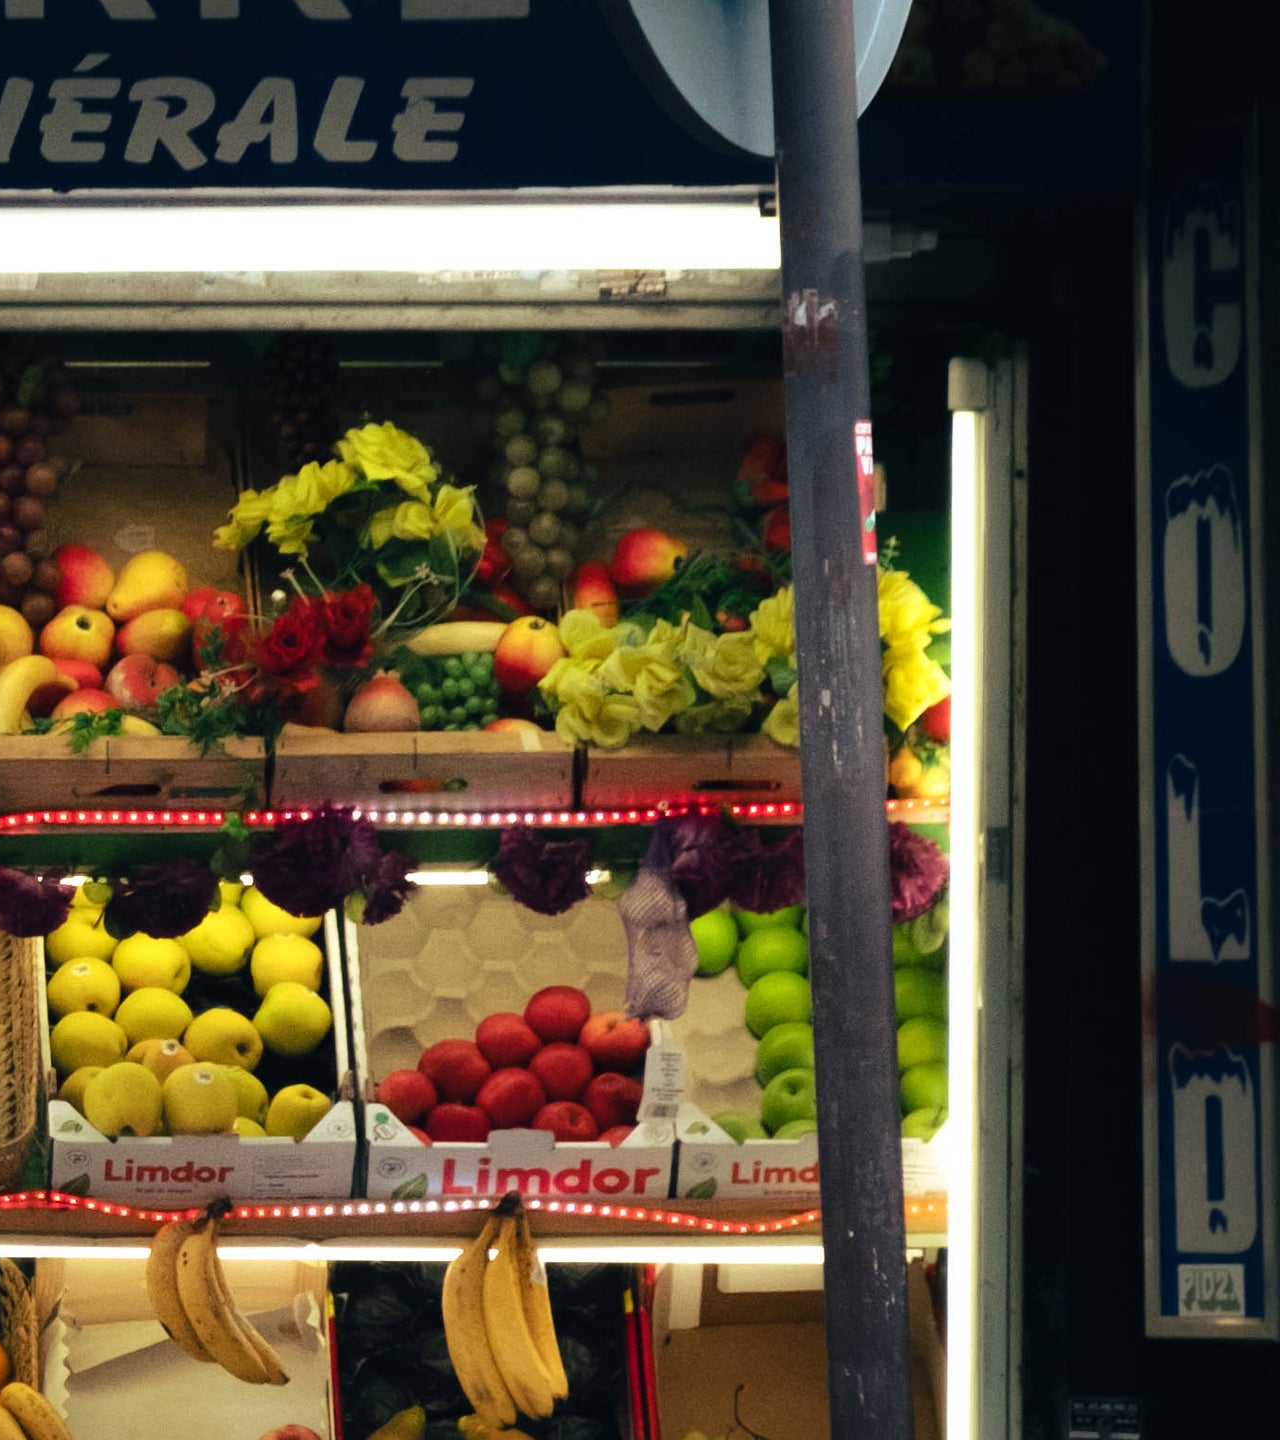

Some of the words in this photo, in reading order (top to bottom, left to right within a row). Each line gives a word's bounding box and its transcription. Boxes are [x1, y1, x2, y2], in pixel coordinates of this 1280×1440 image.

[104, 1159, 235, 1183] Limdor
[441, 1157, 661, 1195] Limdor
[730, 1160, 820, 1185] Limd
